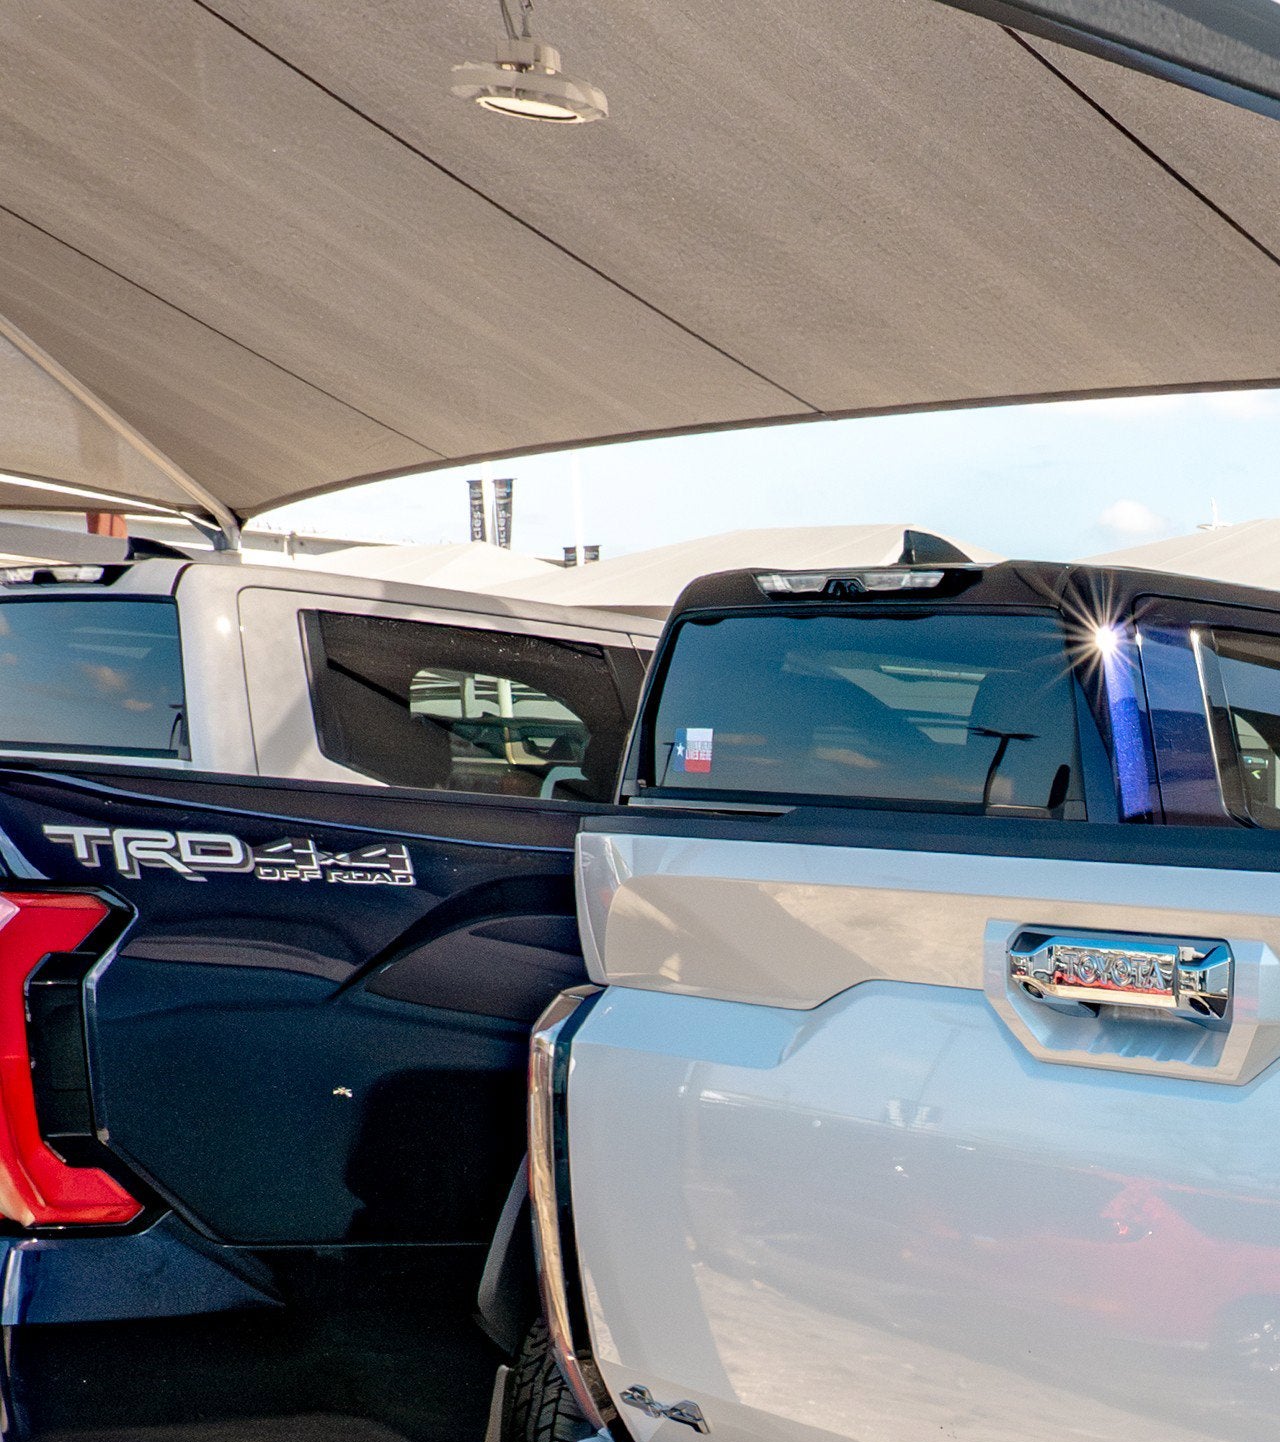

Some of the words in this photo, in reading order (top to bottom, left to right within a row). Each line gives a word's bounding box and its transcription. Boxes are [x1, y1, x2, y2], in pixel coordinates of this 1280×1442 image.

[43, 825, 256, 882] TRD
[256, 866, 323, 883] OFF
[326, 869, 416, 886] ROAD
[1061, 951, 1167, 990] TOYOTA
